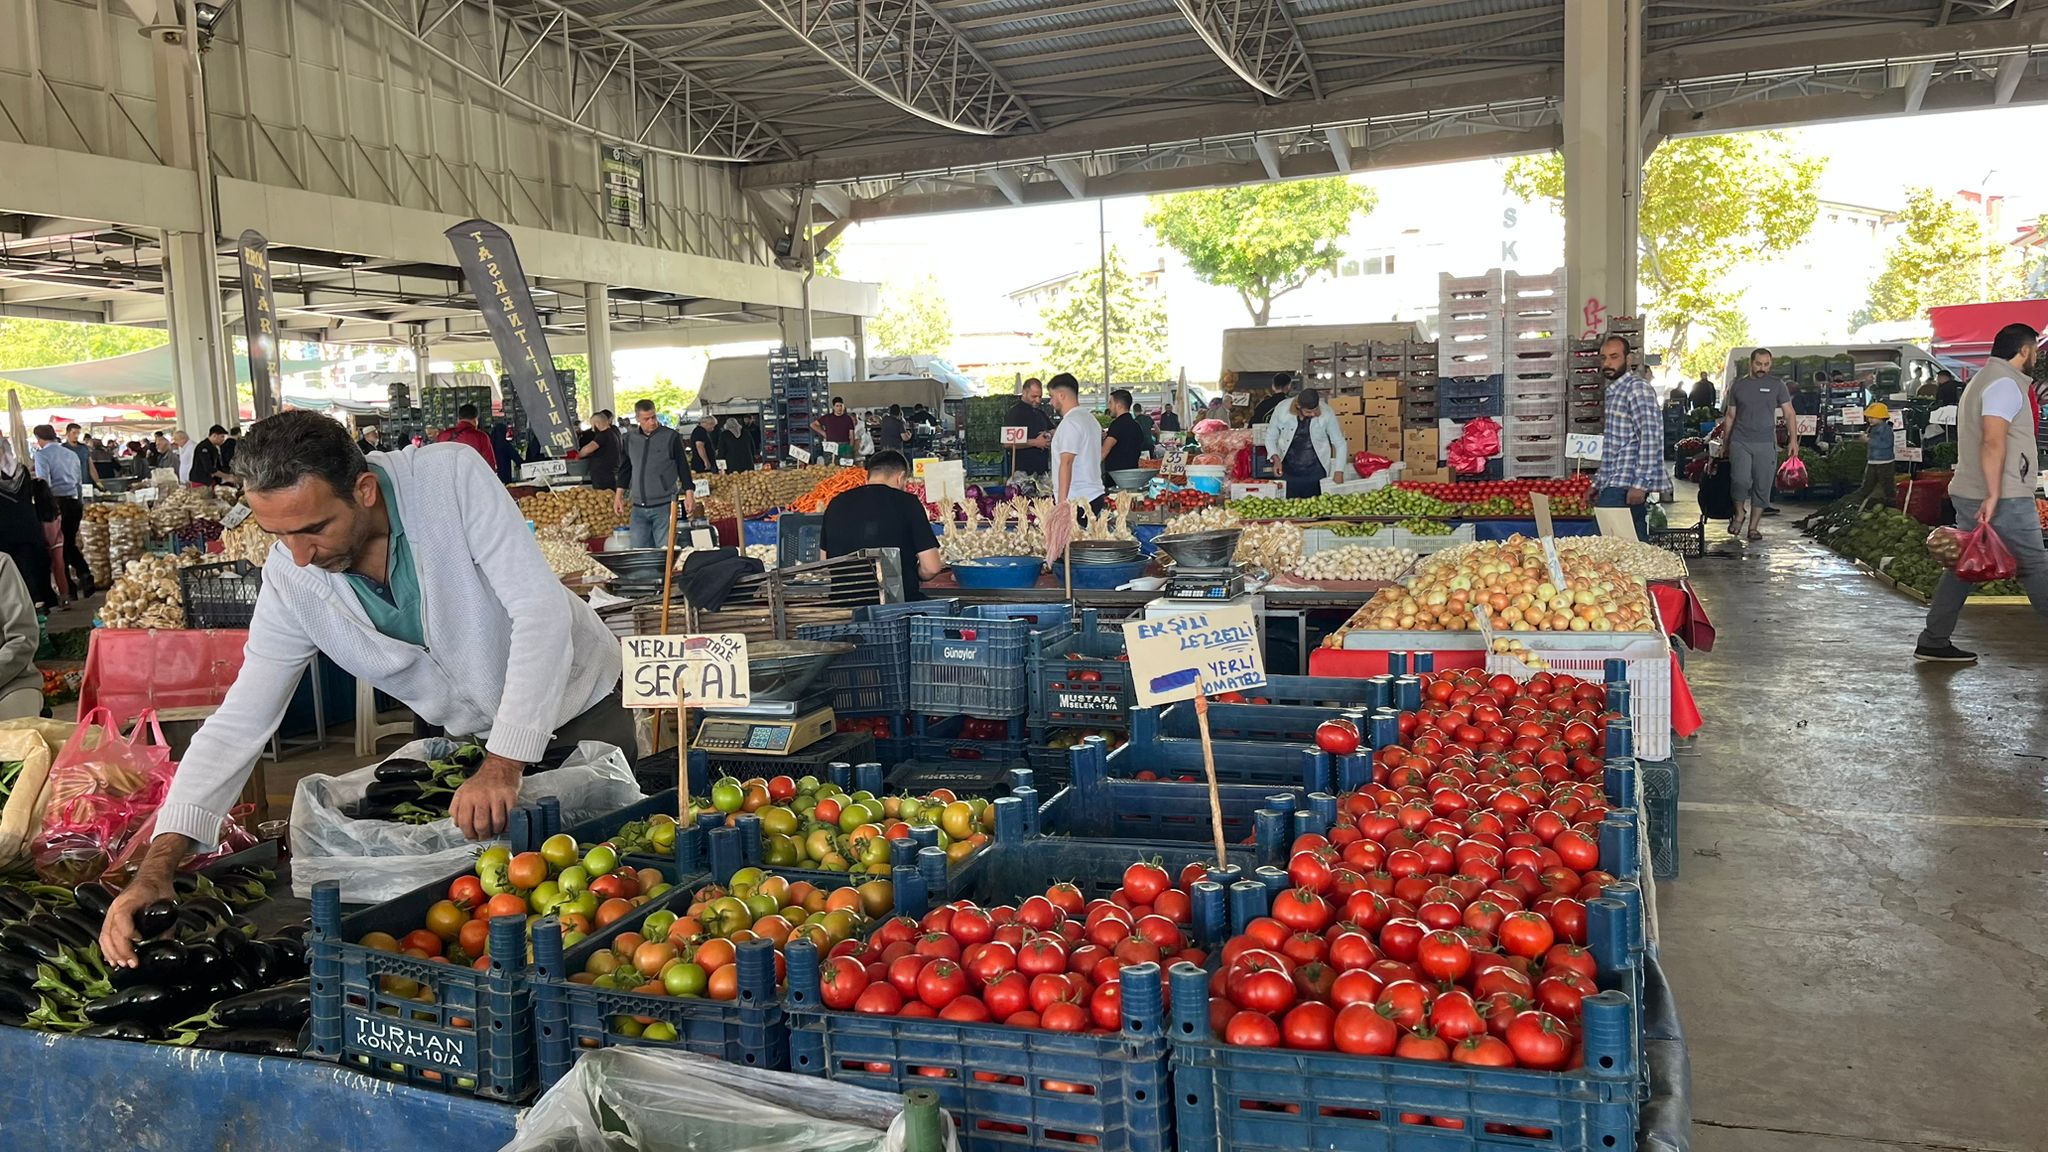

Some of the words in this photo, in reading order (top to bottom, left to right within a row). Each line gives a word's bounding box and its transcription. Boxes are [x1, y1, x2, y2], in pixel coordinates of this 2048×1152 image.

[1006, 428, 1025, 442] 50
[1573, 440, 1597, 454] 20
[1166, 451, 1182, 464] 35
[1059, 693, 1117, 708] MUSTAFA
[355, 1016, 463, 1055] TURHAN
[356, 1032, 462, 1067] KONYA-10/A
